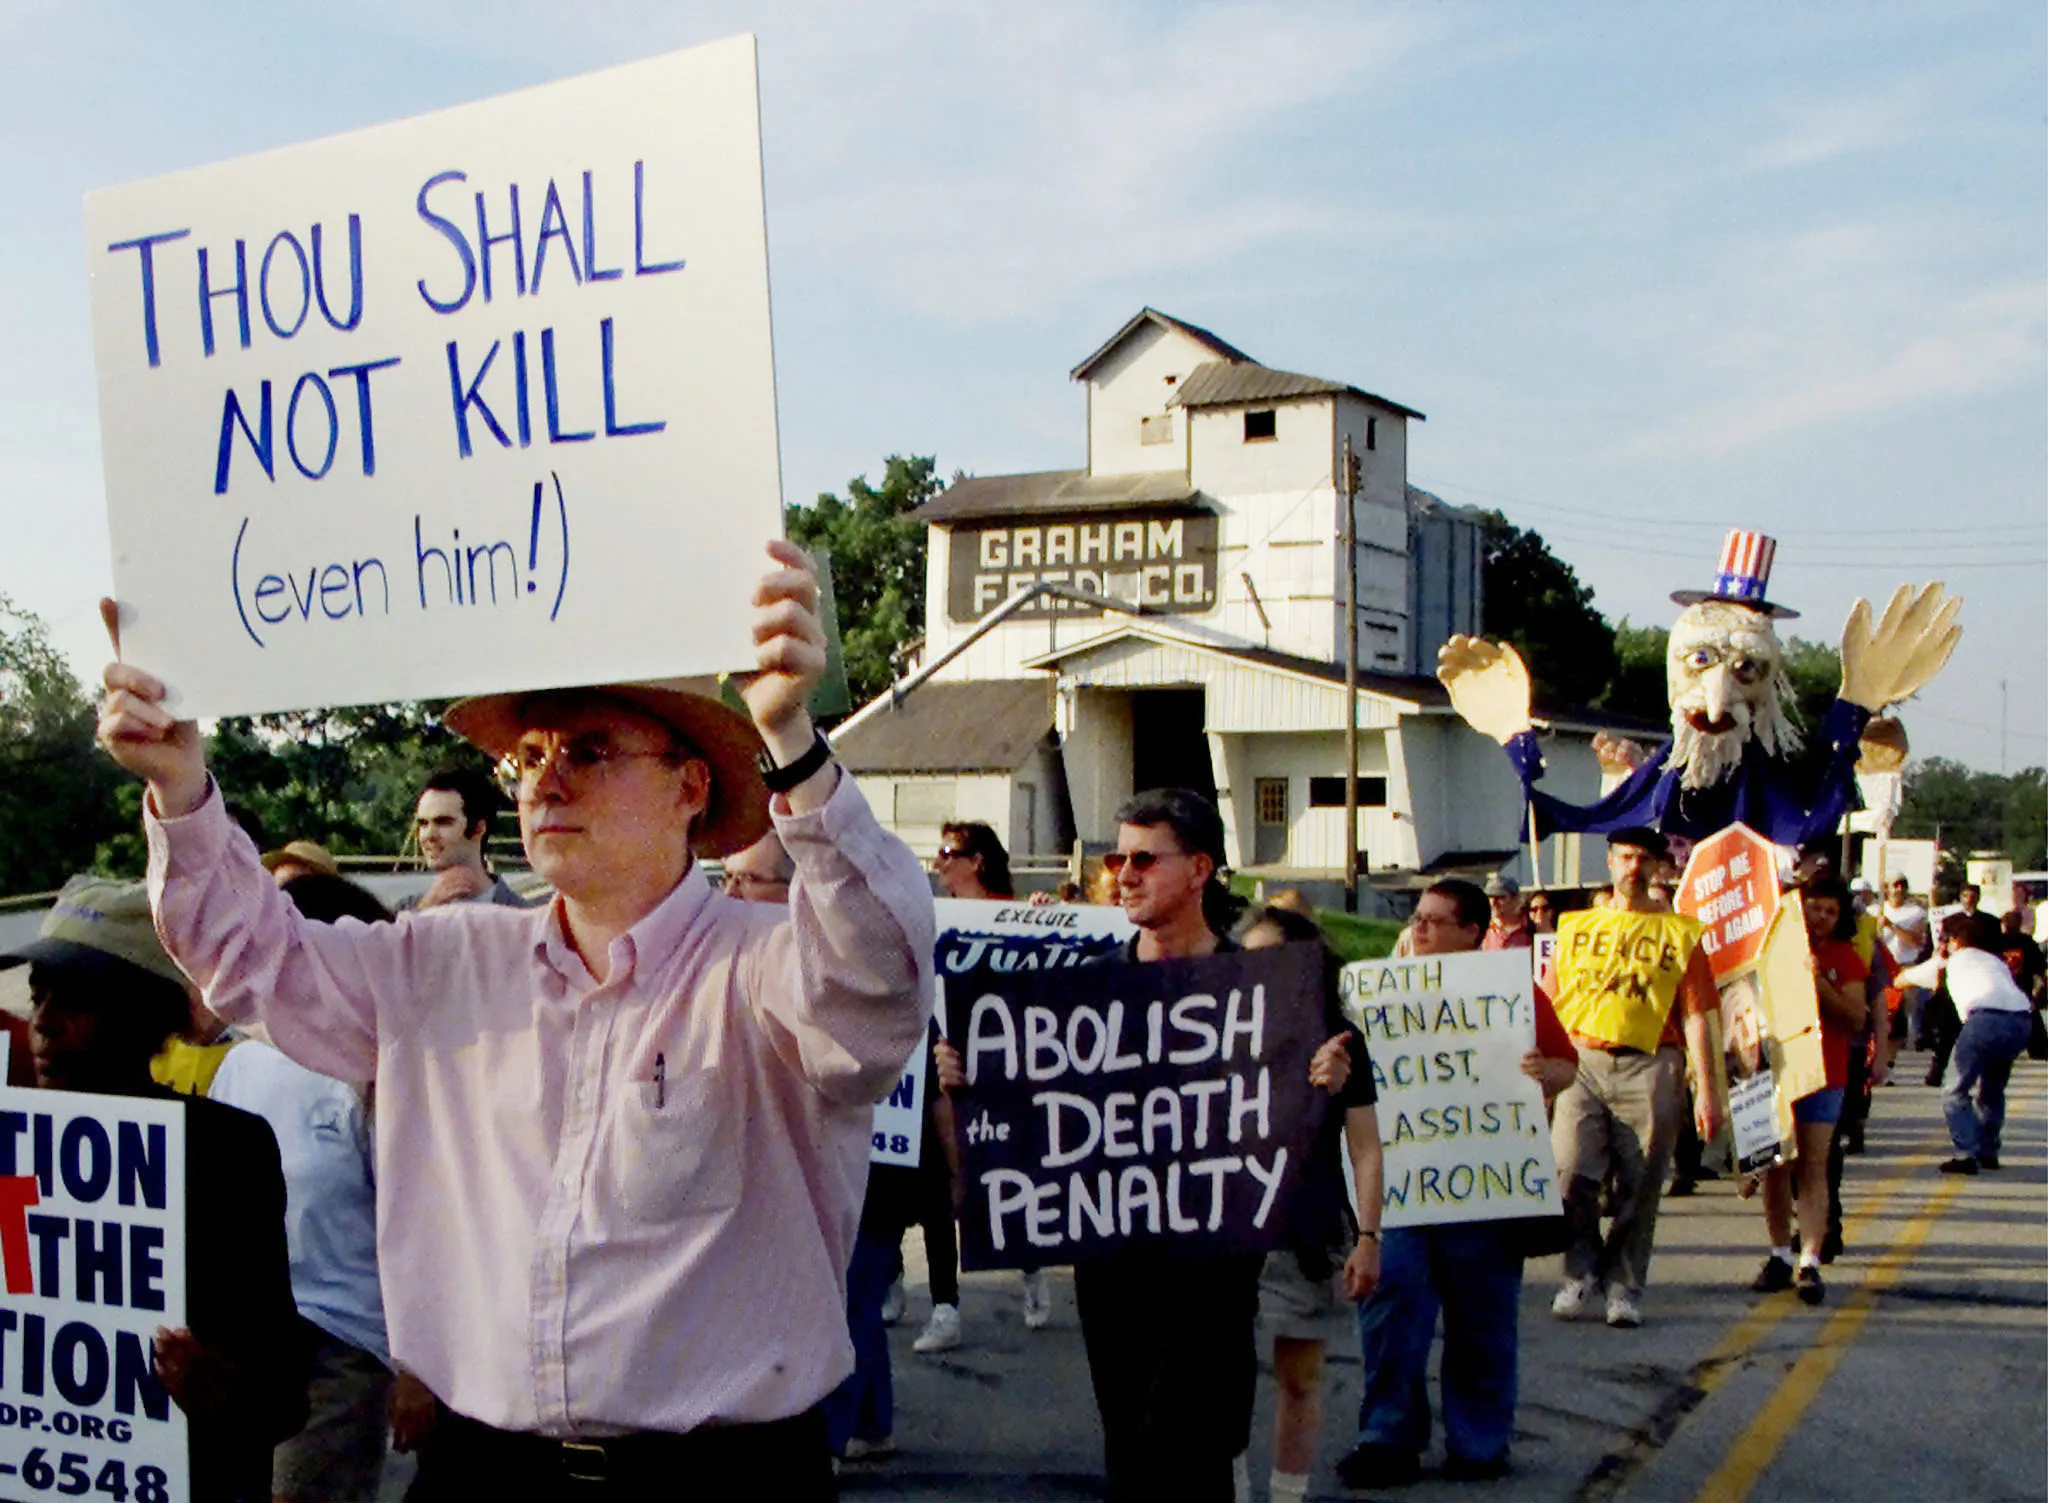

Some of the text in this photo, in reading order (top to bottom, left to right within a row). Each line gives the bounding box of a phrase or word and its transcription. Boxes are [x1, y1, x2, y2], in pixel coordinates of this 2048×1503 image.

[108, 160, 686, 368] THOU SHALL
[214, 317, 666, 495] NOT KILL
[232, 471, 569, 648] (even him!)
[980, 518, 1184, 568] GRAHAM
[1140, 564, 1214, 605] CO.
[1694, 865, 1726, 901] STOP
[994, 908, 1079, 928] EXECUTE
[1342, 960, 1443, 997] DEATH
[965, 983, 1266, 1087] ABOLISH
[1363, 992, 1533, 1042] PENALTY:
[1371, 1049, 1480, 1089] ACIST.
[966, 1067, 1271, 1169] the DEATH
[980, 1147, 1288, 1251] PENALTY
[1382, 1157, 1551, 1208] WRONG
[28, 1213, 166, 1312] THE
